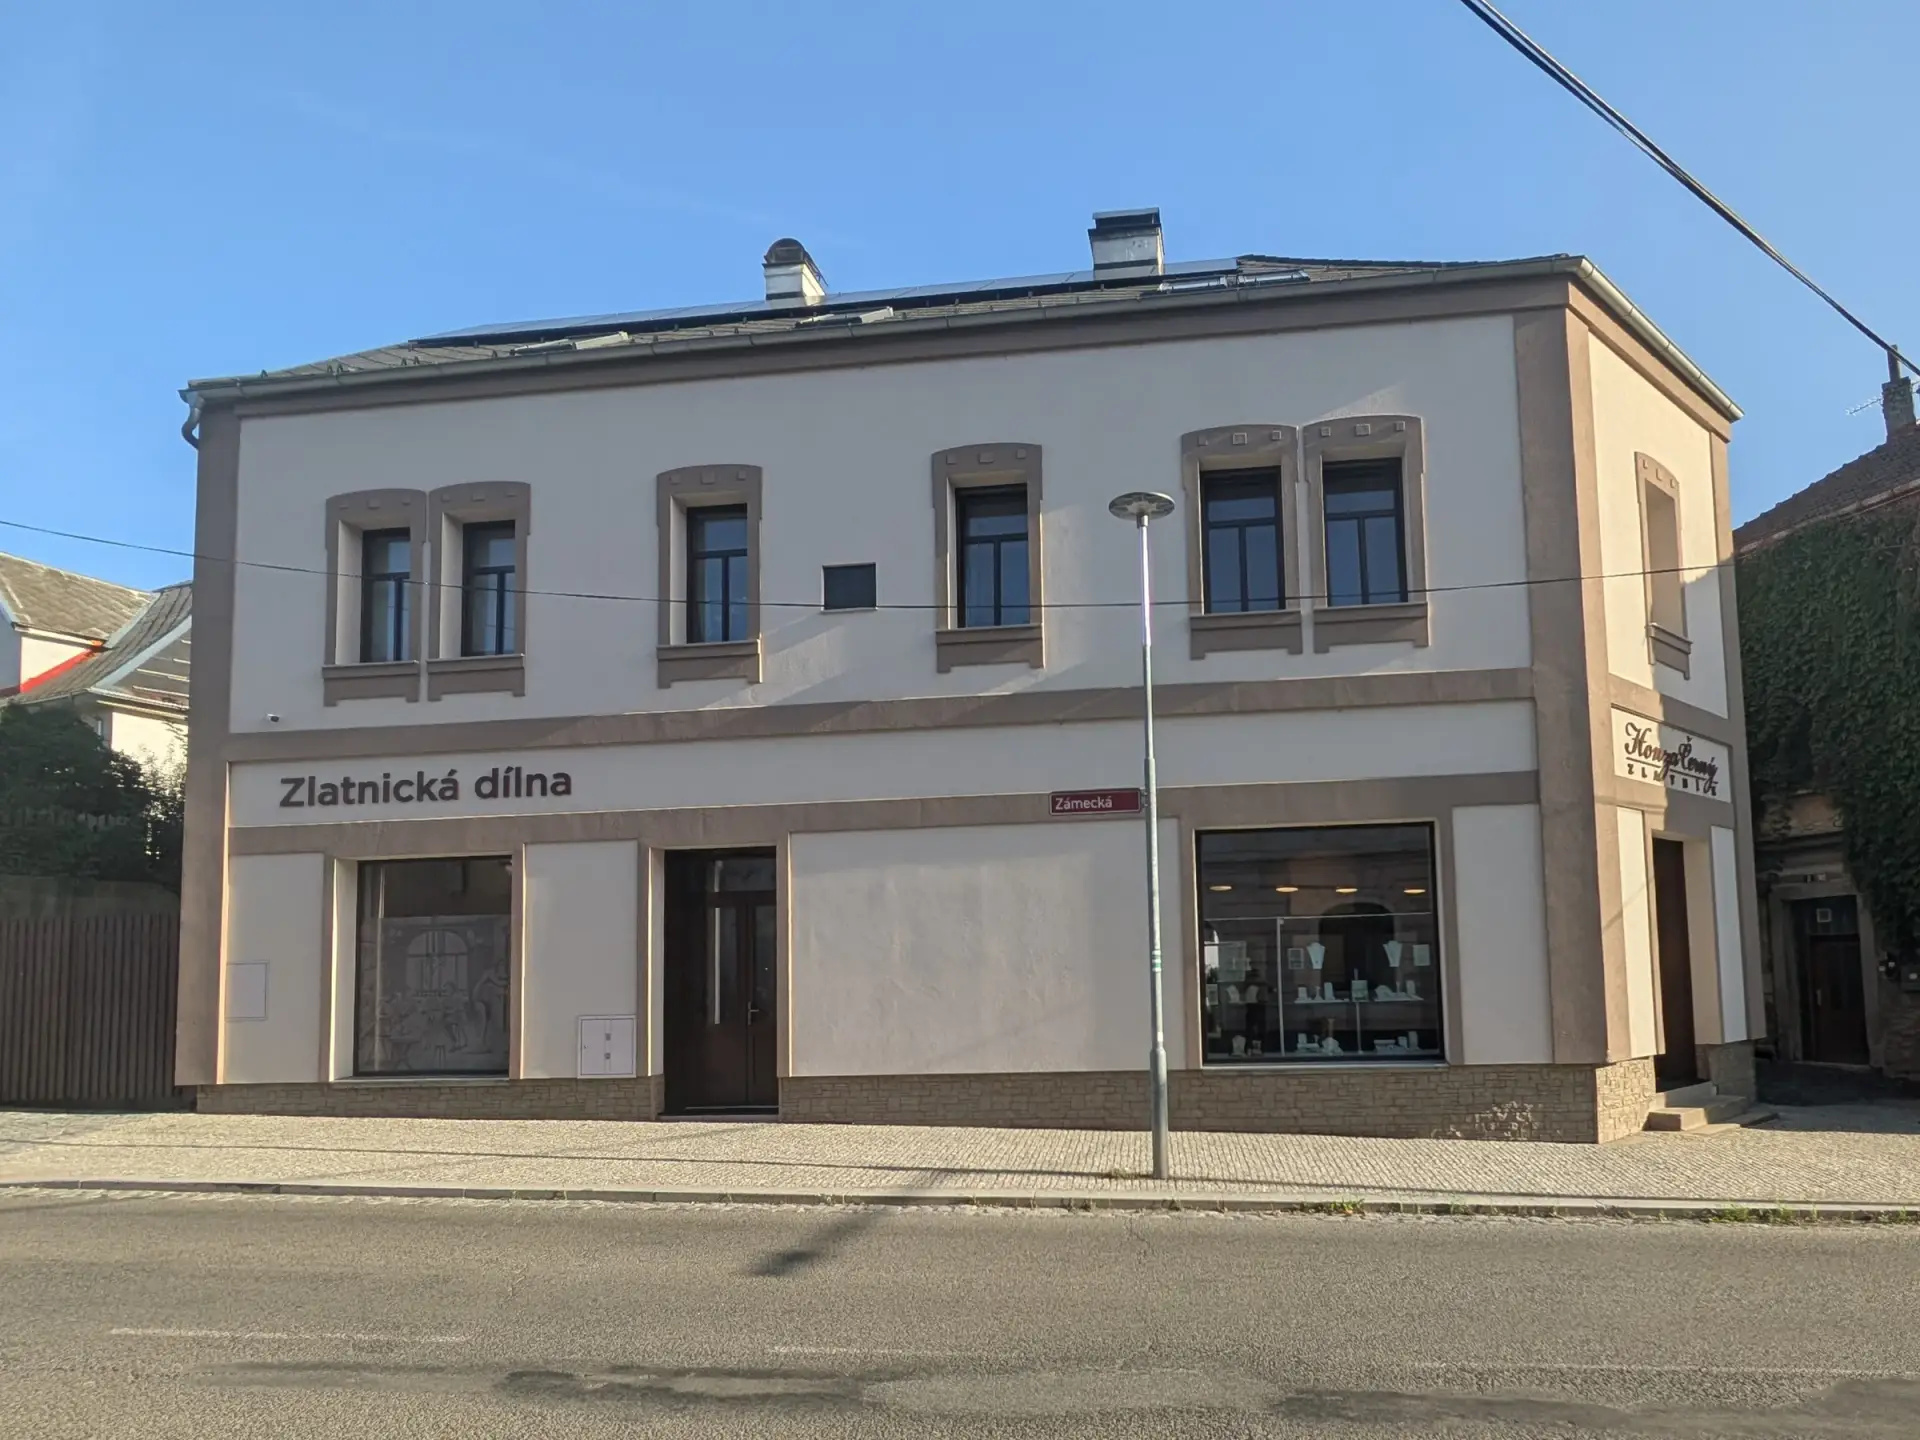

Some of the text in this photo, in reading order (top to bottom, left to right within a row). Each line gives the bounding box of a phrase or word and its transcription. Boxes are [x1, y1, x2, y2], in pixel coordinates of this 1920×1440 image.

[280, 766, 572, 807] Zlatnická dílna
[1055, 796, 1113, 810] Zámecká
